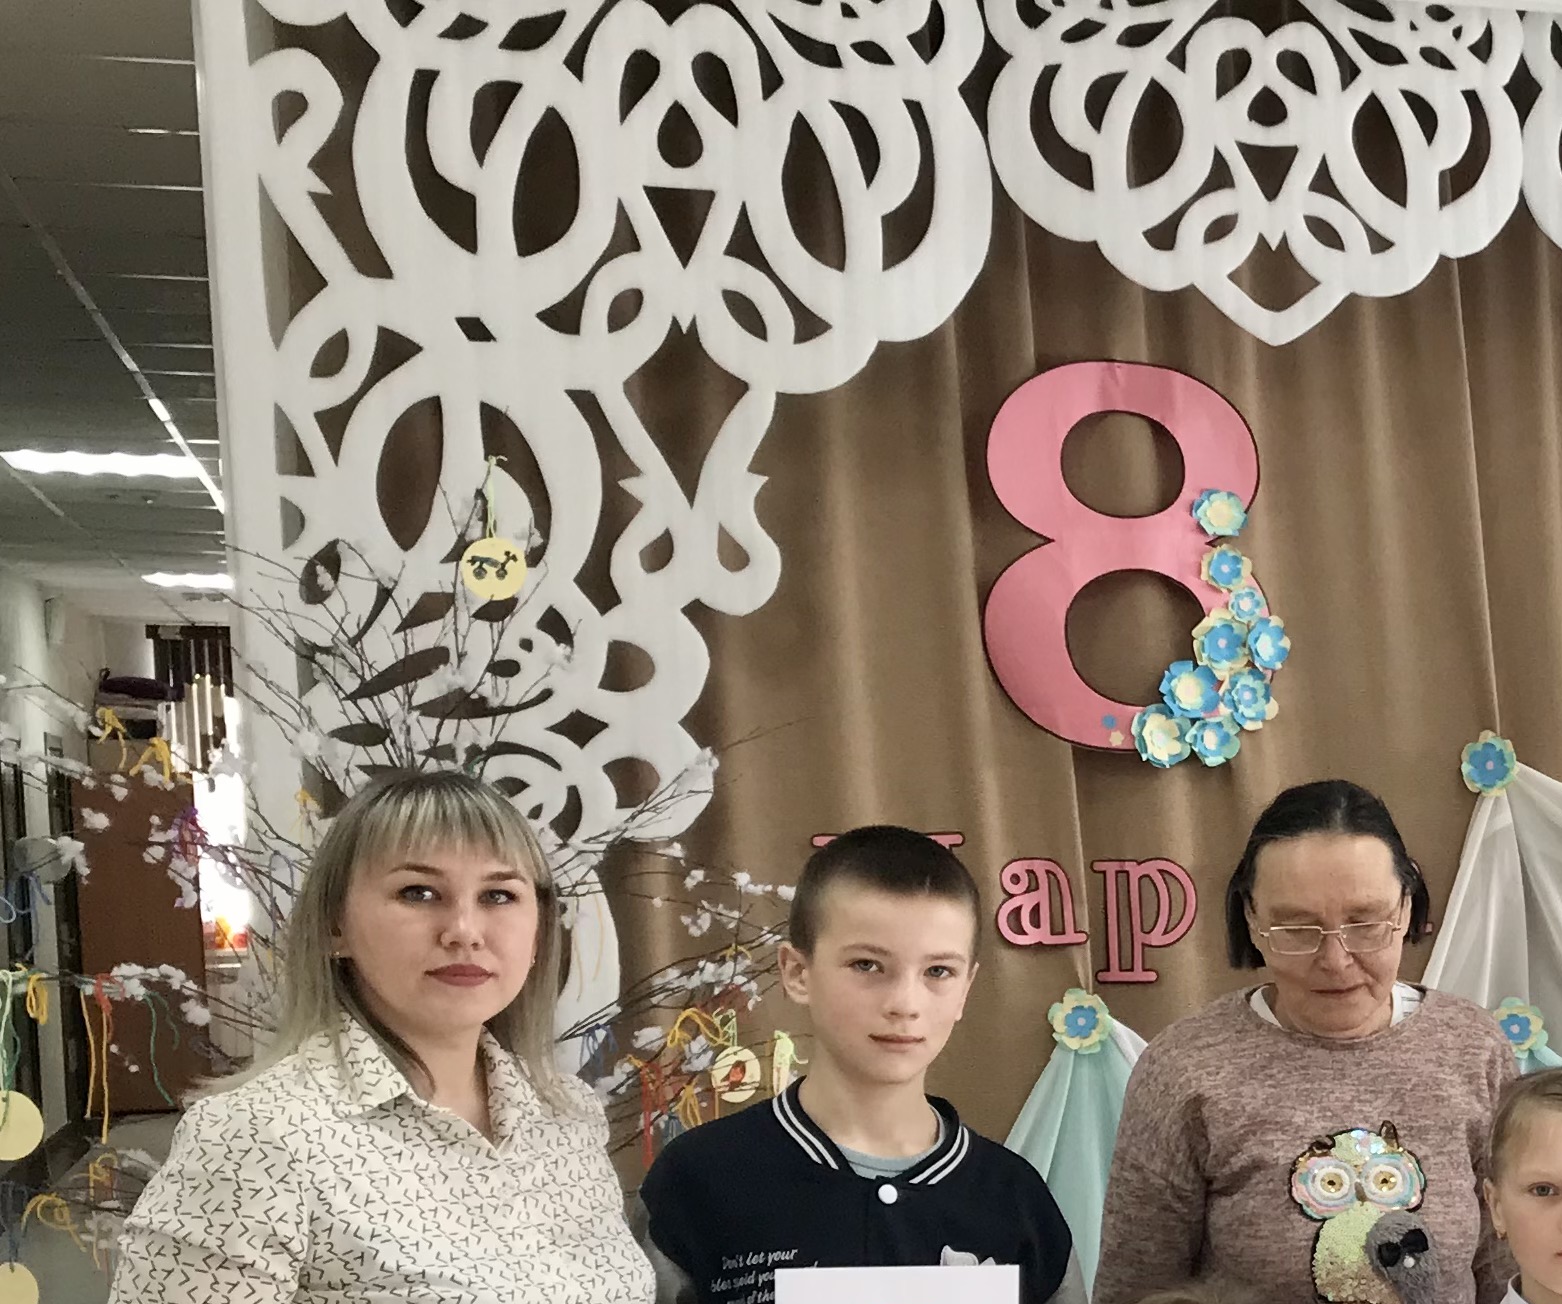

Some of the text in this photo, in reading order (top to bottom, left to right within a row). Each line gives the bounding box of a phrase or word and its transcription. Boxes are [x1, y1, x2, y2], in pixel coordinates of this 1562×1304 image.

[985, 359, 1276, 753] 8
[812, 831, 1198, 984] ар
[746, 1252, 765, 1266] let
[767, 1248, 798, 1267] your
